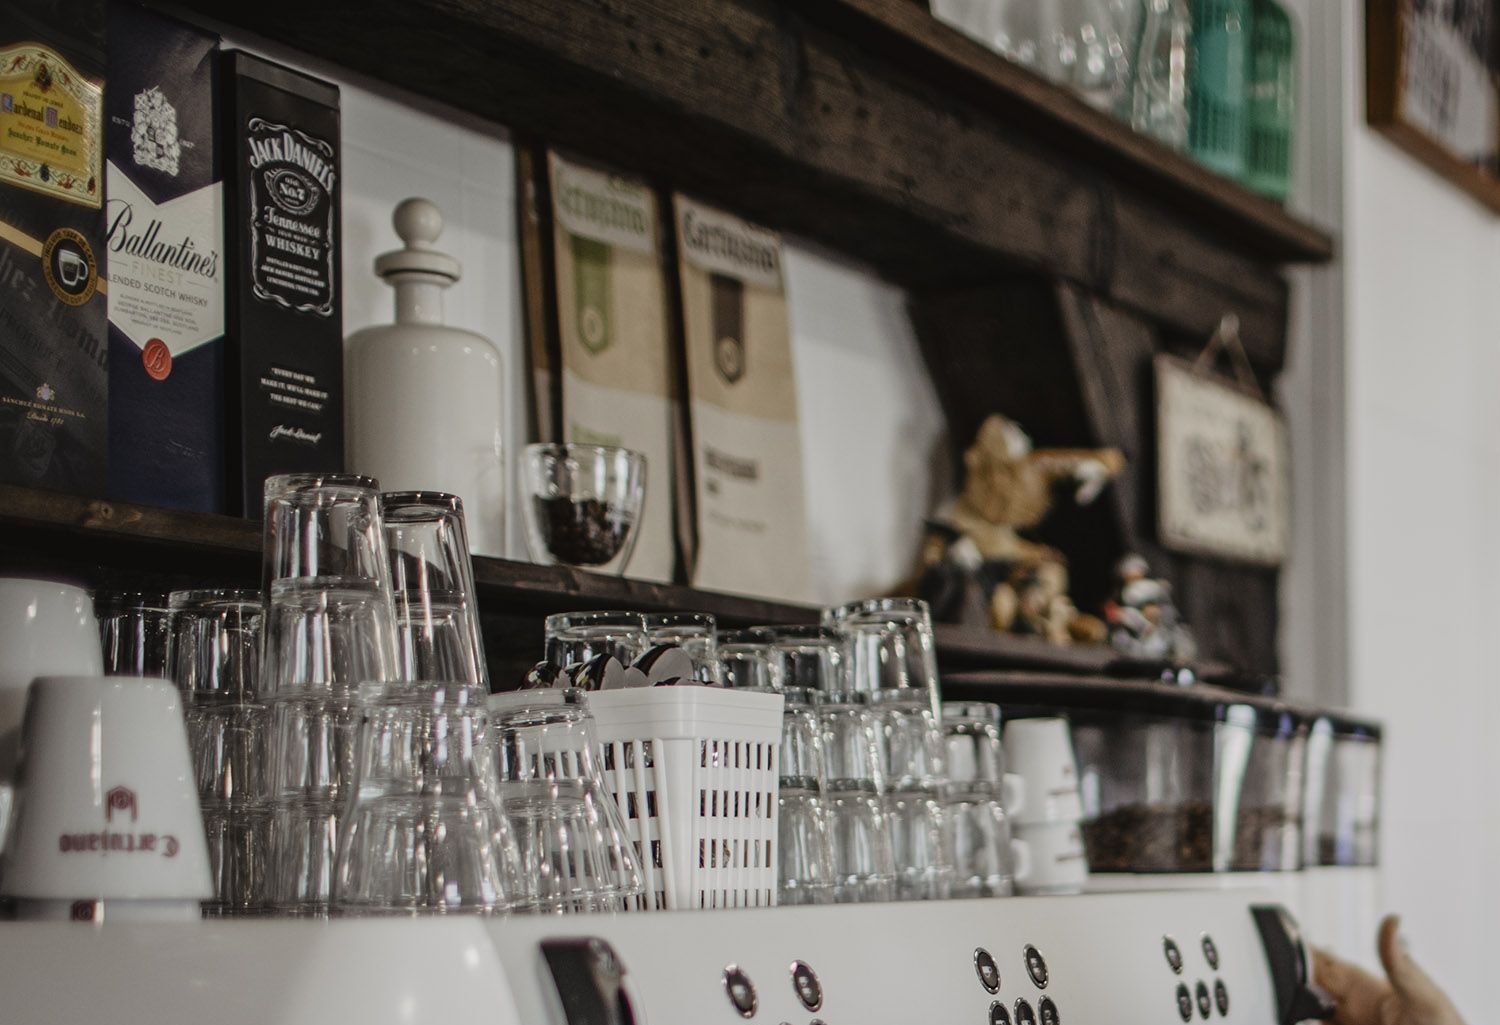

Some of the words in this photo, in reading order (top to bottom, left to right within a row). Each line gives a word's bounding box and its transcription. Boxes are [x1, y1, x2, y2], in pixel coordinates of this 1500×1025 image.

[248, 135, 284, 169] JACK
[282, 132, 336, 195] DANIEL'S
[107, 198, 218, 279] Ballantine's
[264, 206, 322, 239] Tennessee
[265, 234, 322, 261] WHISKEY
[107, 273, 142, 289] LENDED
[144, 282, 177, 299] SCOTCH
[178, 291, 208, 307] WHISKY
[130, 261, 184, 287] FINEST
